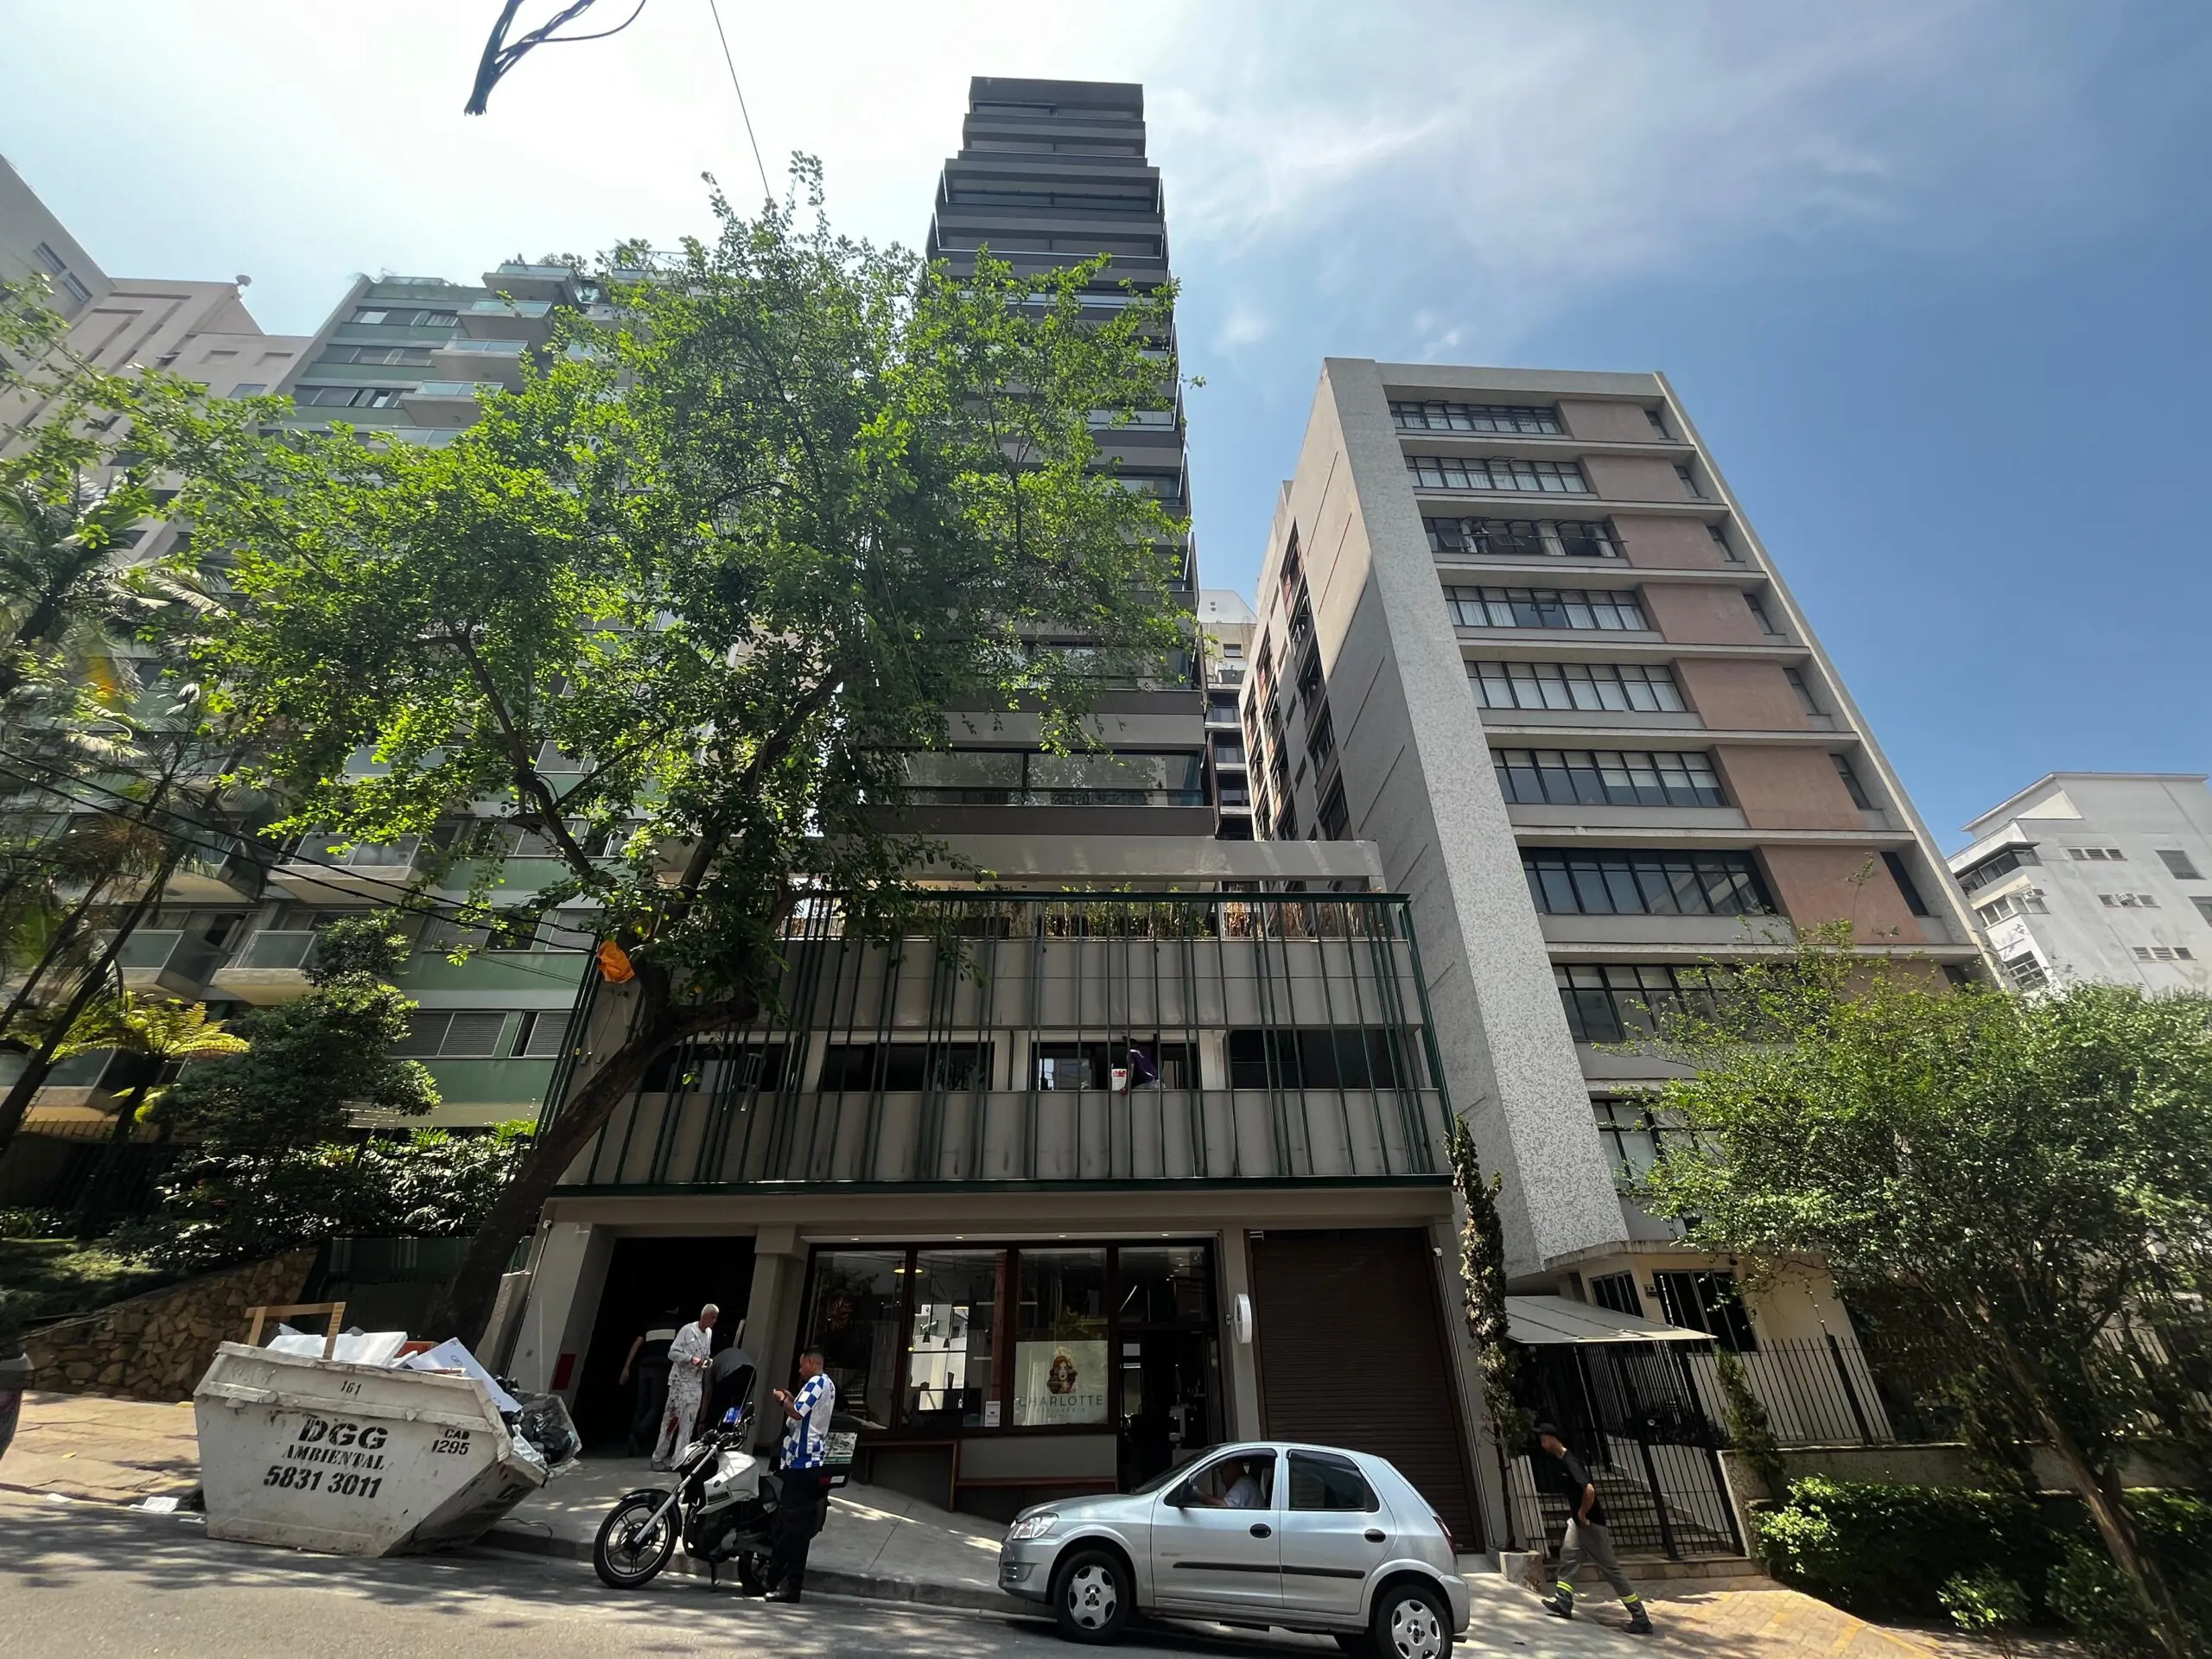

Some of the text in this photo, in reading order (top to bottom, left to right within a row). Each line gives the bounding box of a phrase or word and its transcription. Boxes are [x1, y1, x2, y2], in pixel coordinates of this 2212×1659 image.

[340, 1380, 362, 1395] 161
[1018, 1395, 1104, 1408] CHARLOTTE
[298, 1418, 388, 1449] DGG
[282, 1445, 386, 1470] AMBIENTAL
[432, 1440, 470, 1455] 1295
[264, 1465, 383, 1498] 5831 3011
